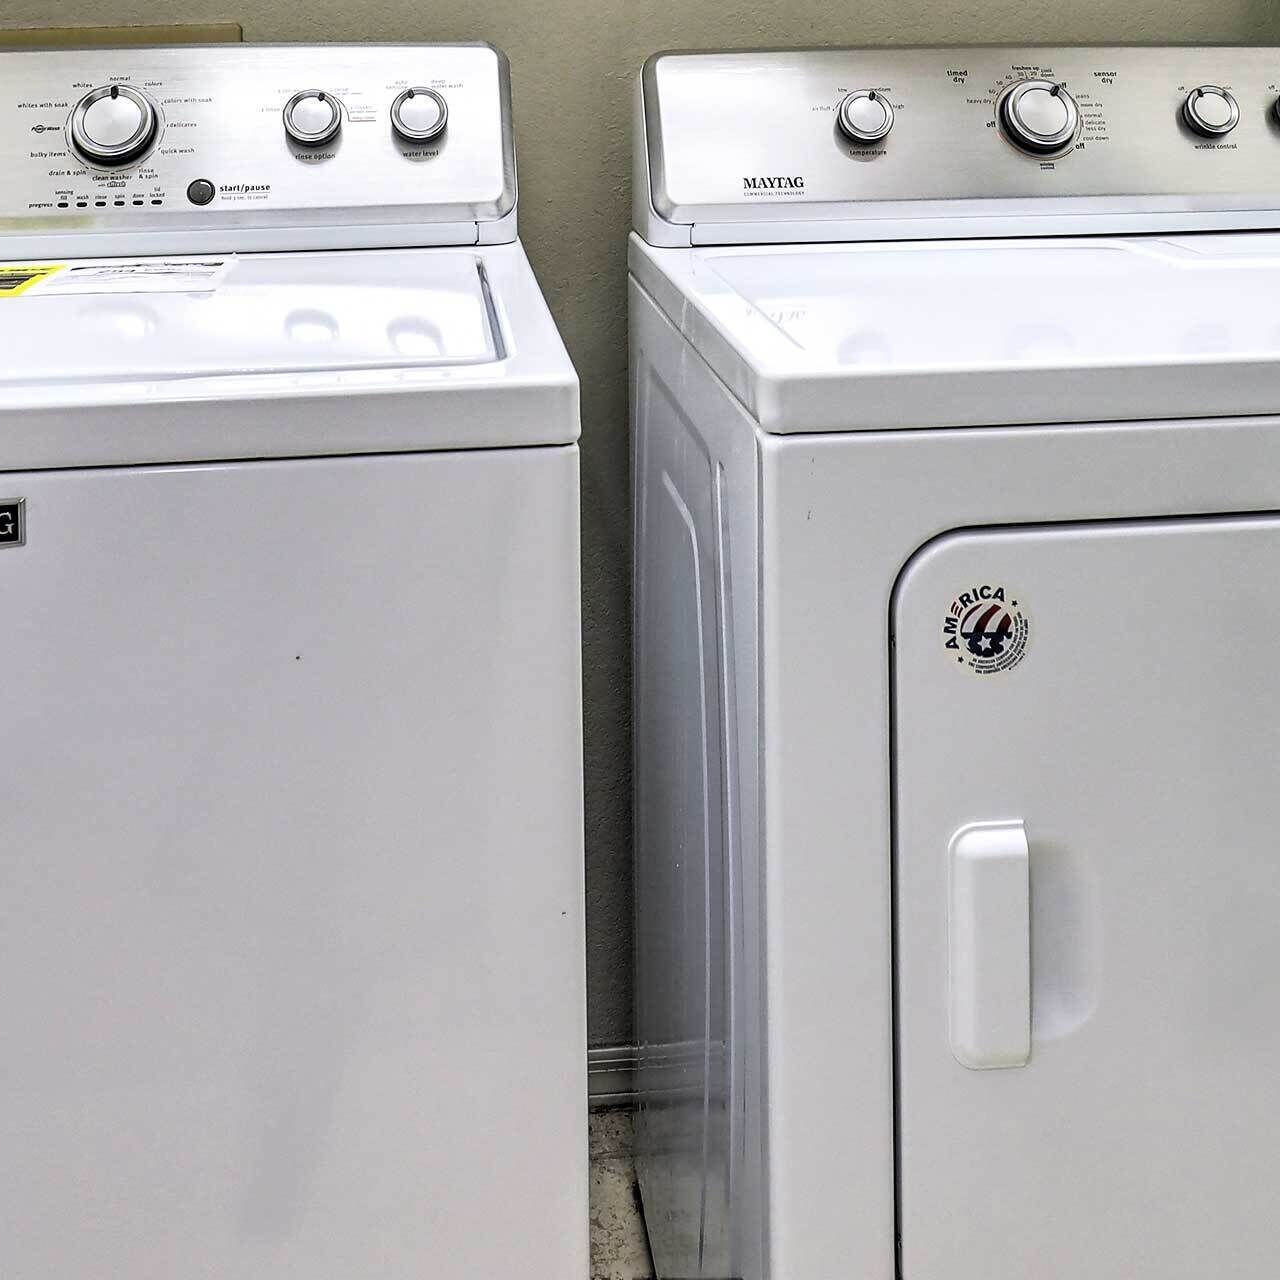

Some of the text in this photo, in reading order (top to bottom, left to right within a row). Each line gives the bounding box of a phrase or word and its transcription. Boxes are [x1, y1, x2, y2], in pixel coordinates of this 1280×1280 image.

[953, 76, 966, 84] dry
[1101, 77, 1113, 85] dry
[1075, 142, 1085, 150] off
[743, 176, 805, 189] MAYTAG
[220, 184, 271, 192] start/pause
[943, 585, 1005, 649] AMERICA
